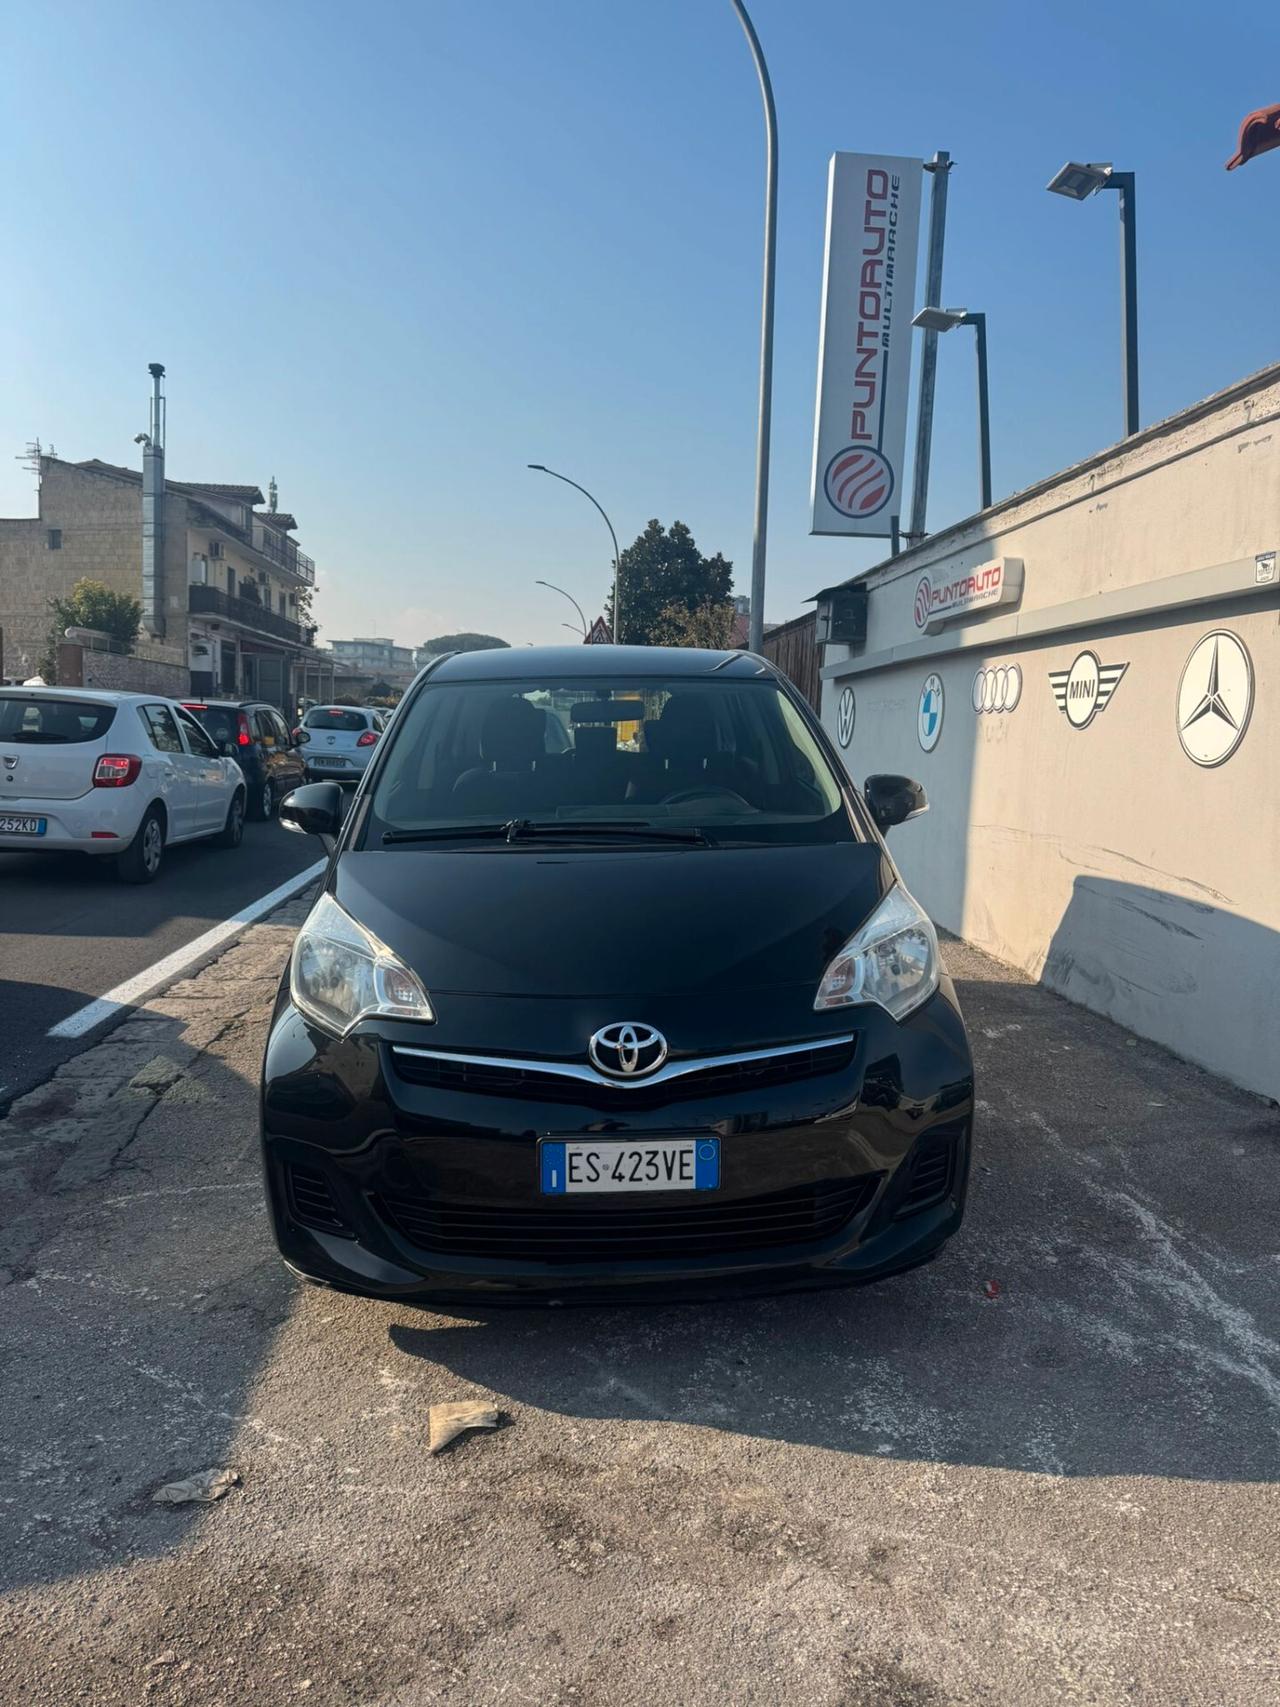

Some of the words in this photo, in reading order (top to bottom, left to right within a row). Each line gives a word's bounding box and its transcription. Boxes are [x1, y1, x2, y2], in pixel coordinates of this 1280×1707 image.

[851, 168, 889, 440] PUNTOAUTO
[881, 174, 900, 348] MULTIMARCHE
[931, 566, 1001, 606] PUNTOAUTO
[1069, 679, 1095, 699] MINI
